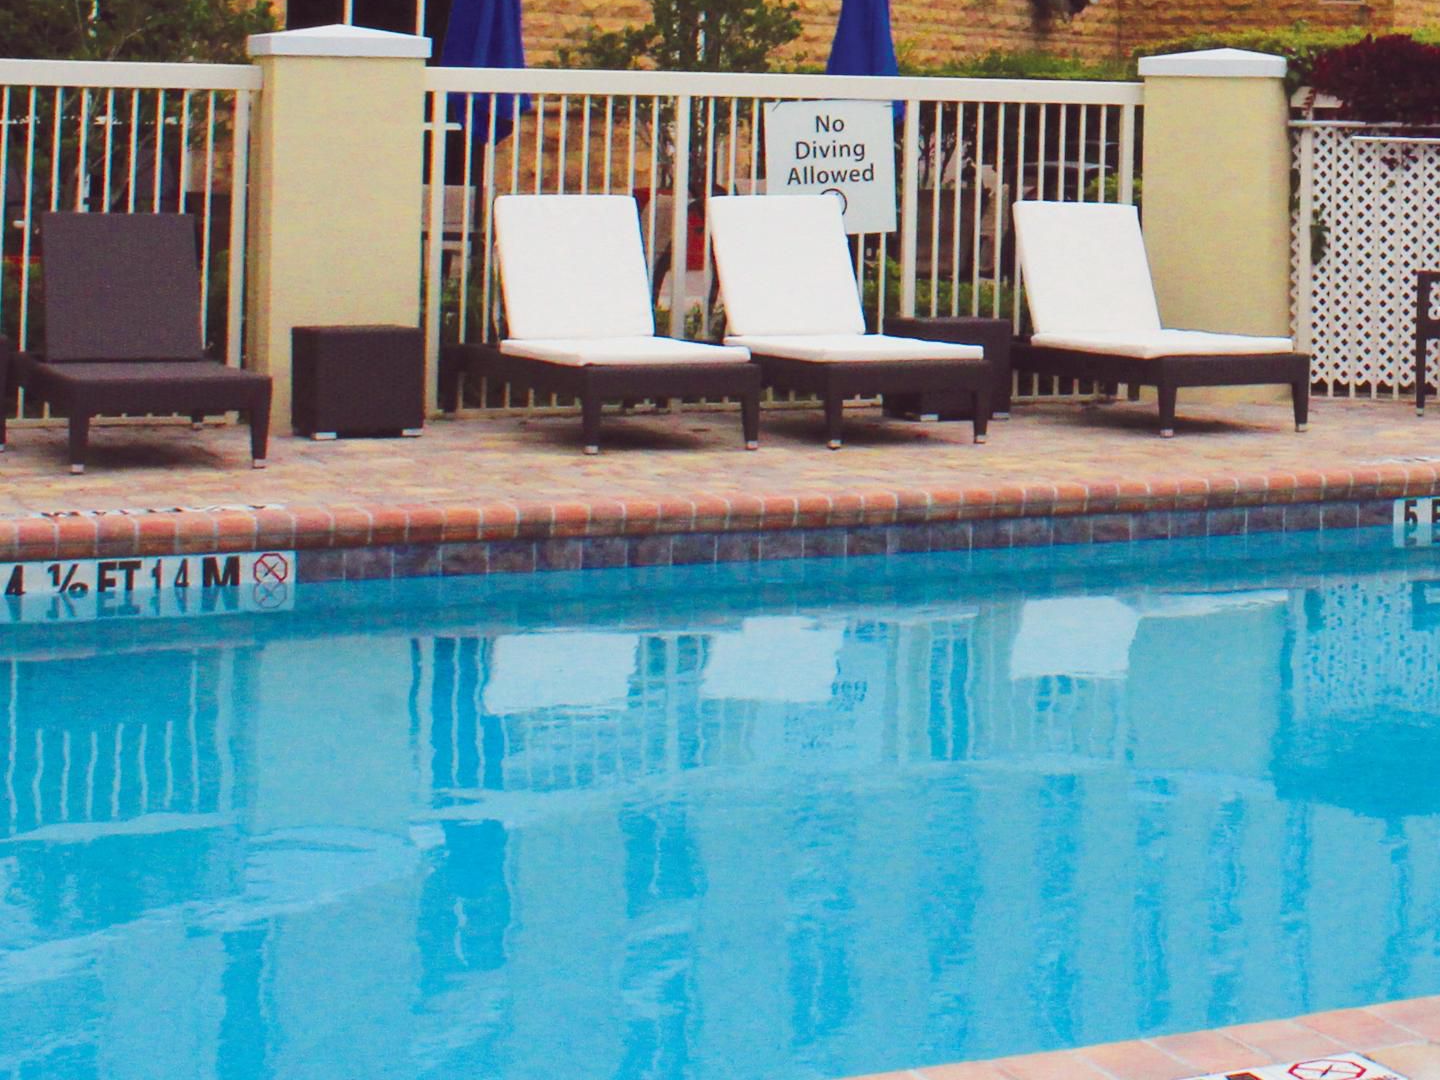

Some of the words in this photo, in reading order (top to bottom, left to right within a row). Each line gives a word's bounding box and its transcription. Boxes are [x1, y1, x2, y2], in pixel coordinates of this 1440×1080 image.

[815, 115, 845, 132] No
[795, 140, 865, 162] Diving
[787, 163, 874, 185] Allowed
[4, 564, 26, 596] 4
[97, 561, 142, 593] FT
[203, 555, 240, 587] M
